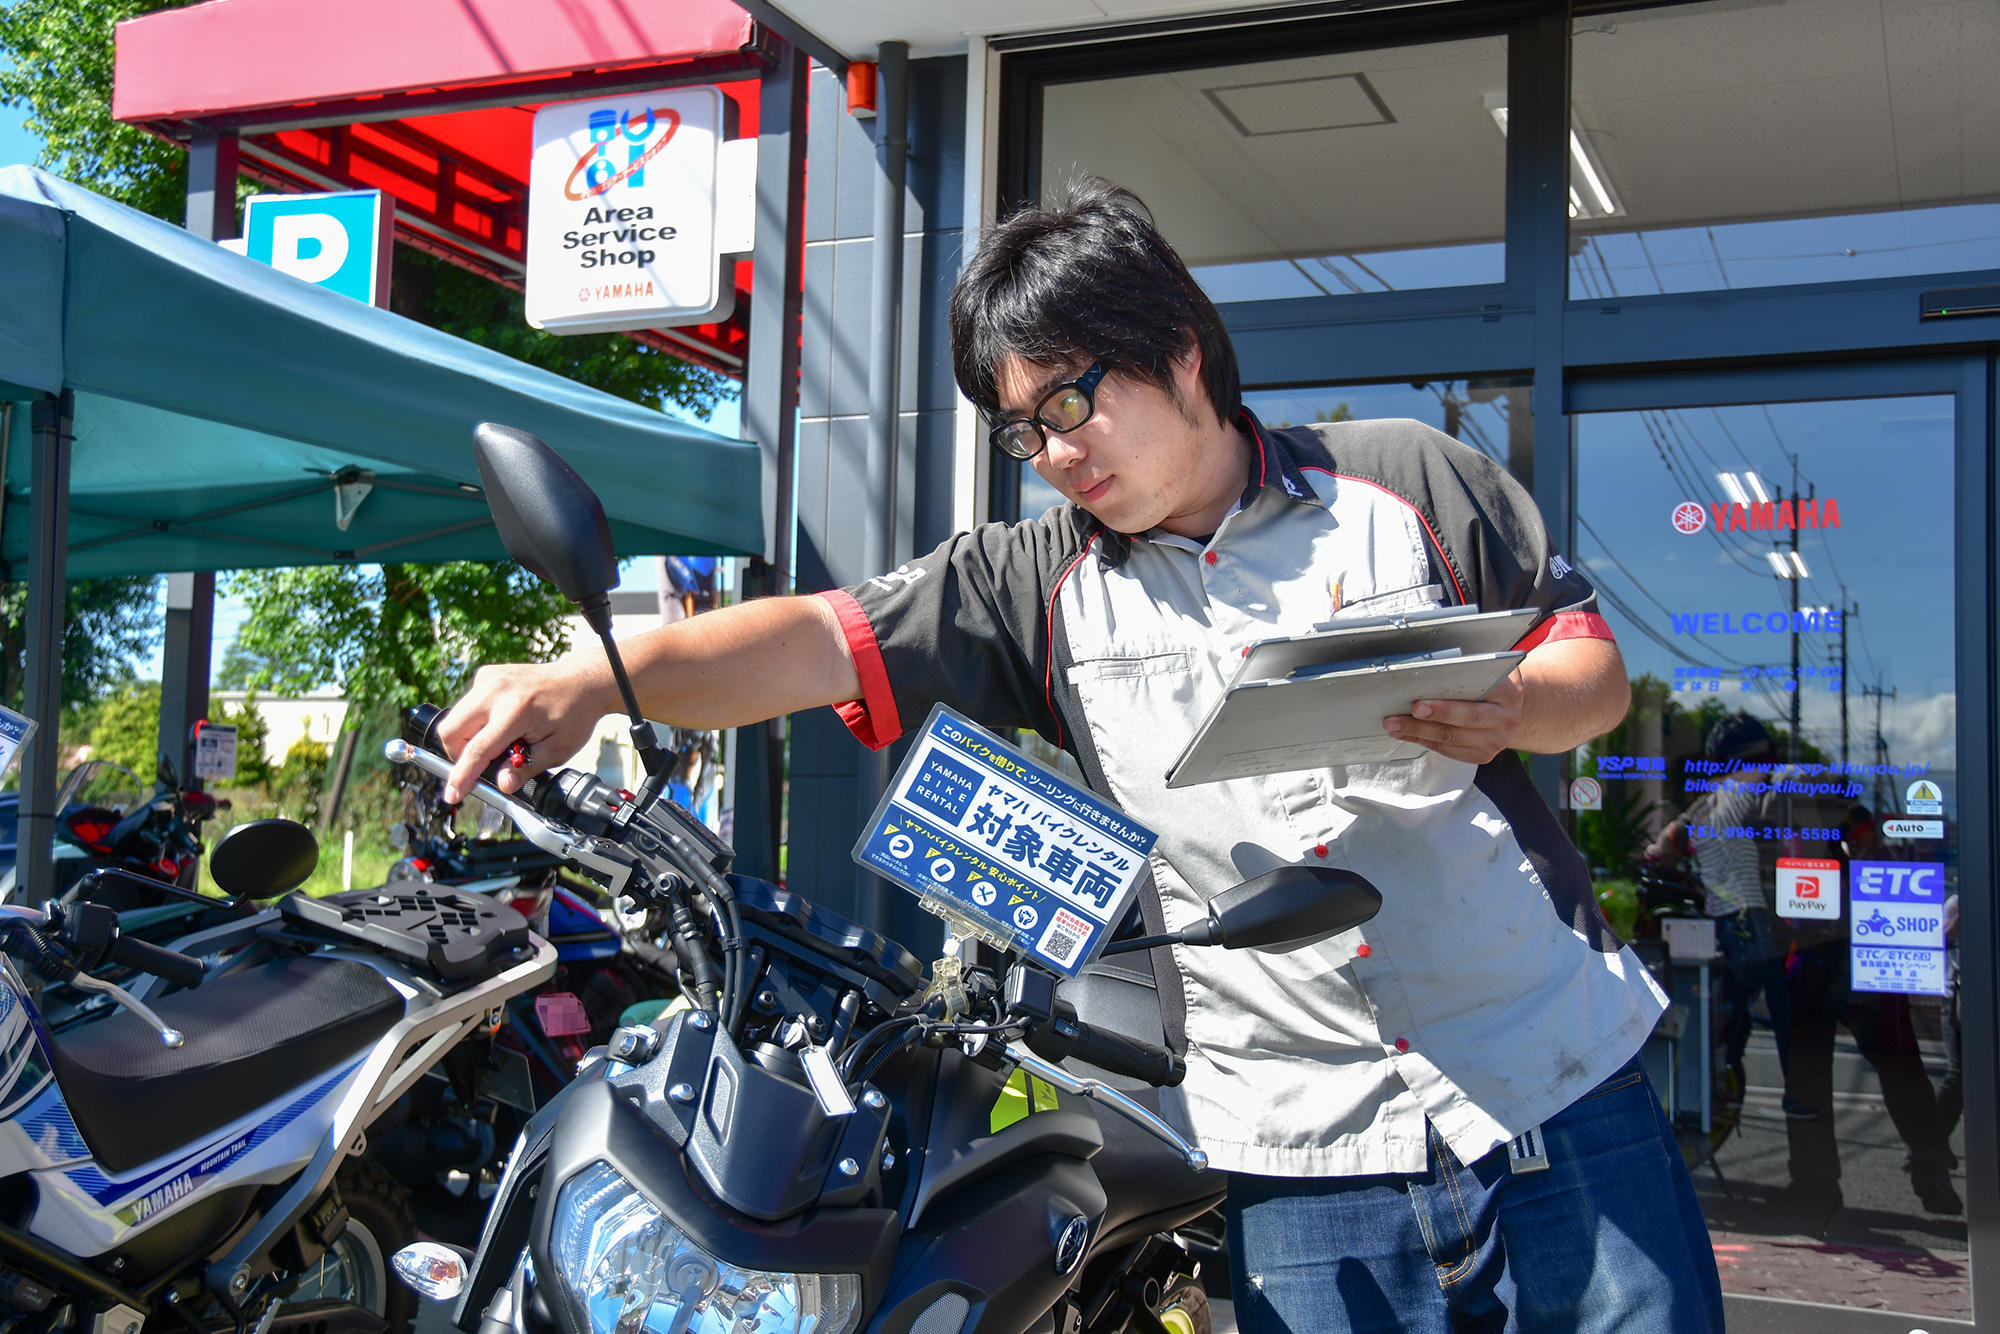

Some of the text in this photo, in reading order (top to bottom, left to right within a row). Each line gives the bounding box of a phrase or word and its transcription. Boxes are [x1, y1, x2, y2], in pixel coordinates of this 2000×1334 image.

[583, 206, 654, 226] Area
[272, 213, 349, 283] P
[563, 223, 678, 249] Service
[580, 249, 656, 269] Shop
[595, 281, 654, 300] YAMAHA
[1710, 498, 1841, 532] YAMAHA
[1671, 611, 1843, 634] WELCOME
[929, 760, 973, 791] YAMAHA
[1597, 756, 1634, 771] YSP
[1684, 760, 1930, 777] http://www.ysp-kikuyou.jp/
[916, 785, 960, 815] RENTAL
[922, 772, 967, 803] BIKE
[1684, 779, 1864, 797] bike@ysp-kikuyou.jp
[987, 783, 1131, 873] ヤマハ バイクレンタル
[1685, 825, 1841, 841] TEL:096-213-5588
[904, 818, 988, 870] ヤマハバイクレンタル
[987, 866, 1039, 901] 安心ポイント
[966, 801, 1123, 910] 対象車両
[1858, 866, 1936, 896] ETC
[1788, 900, 1827, 911] PayPay
[1896, 917, 1939, 932] SHOP
[132, 1173, 194, 1222] YAMAHA
